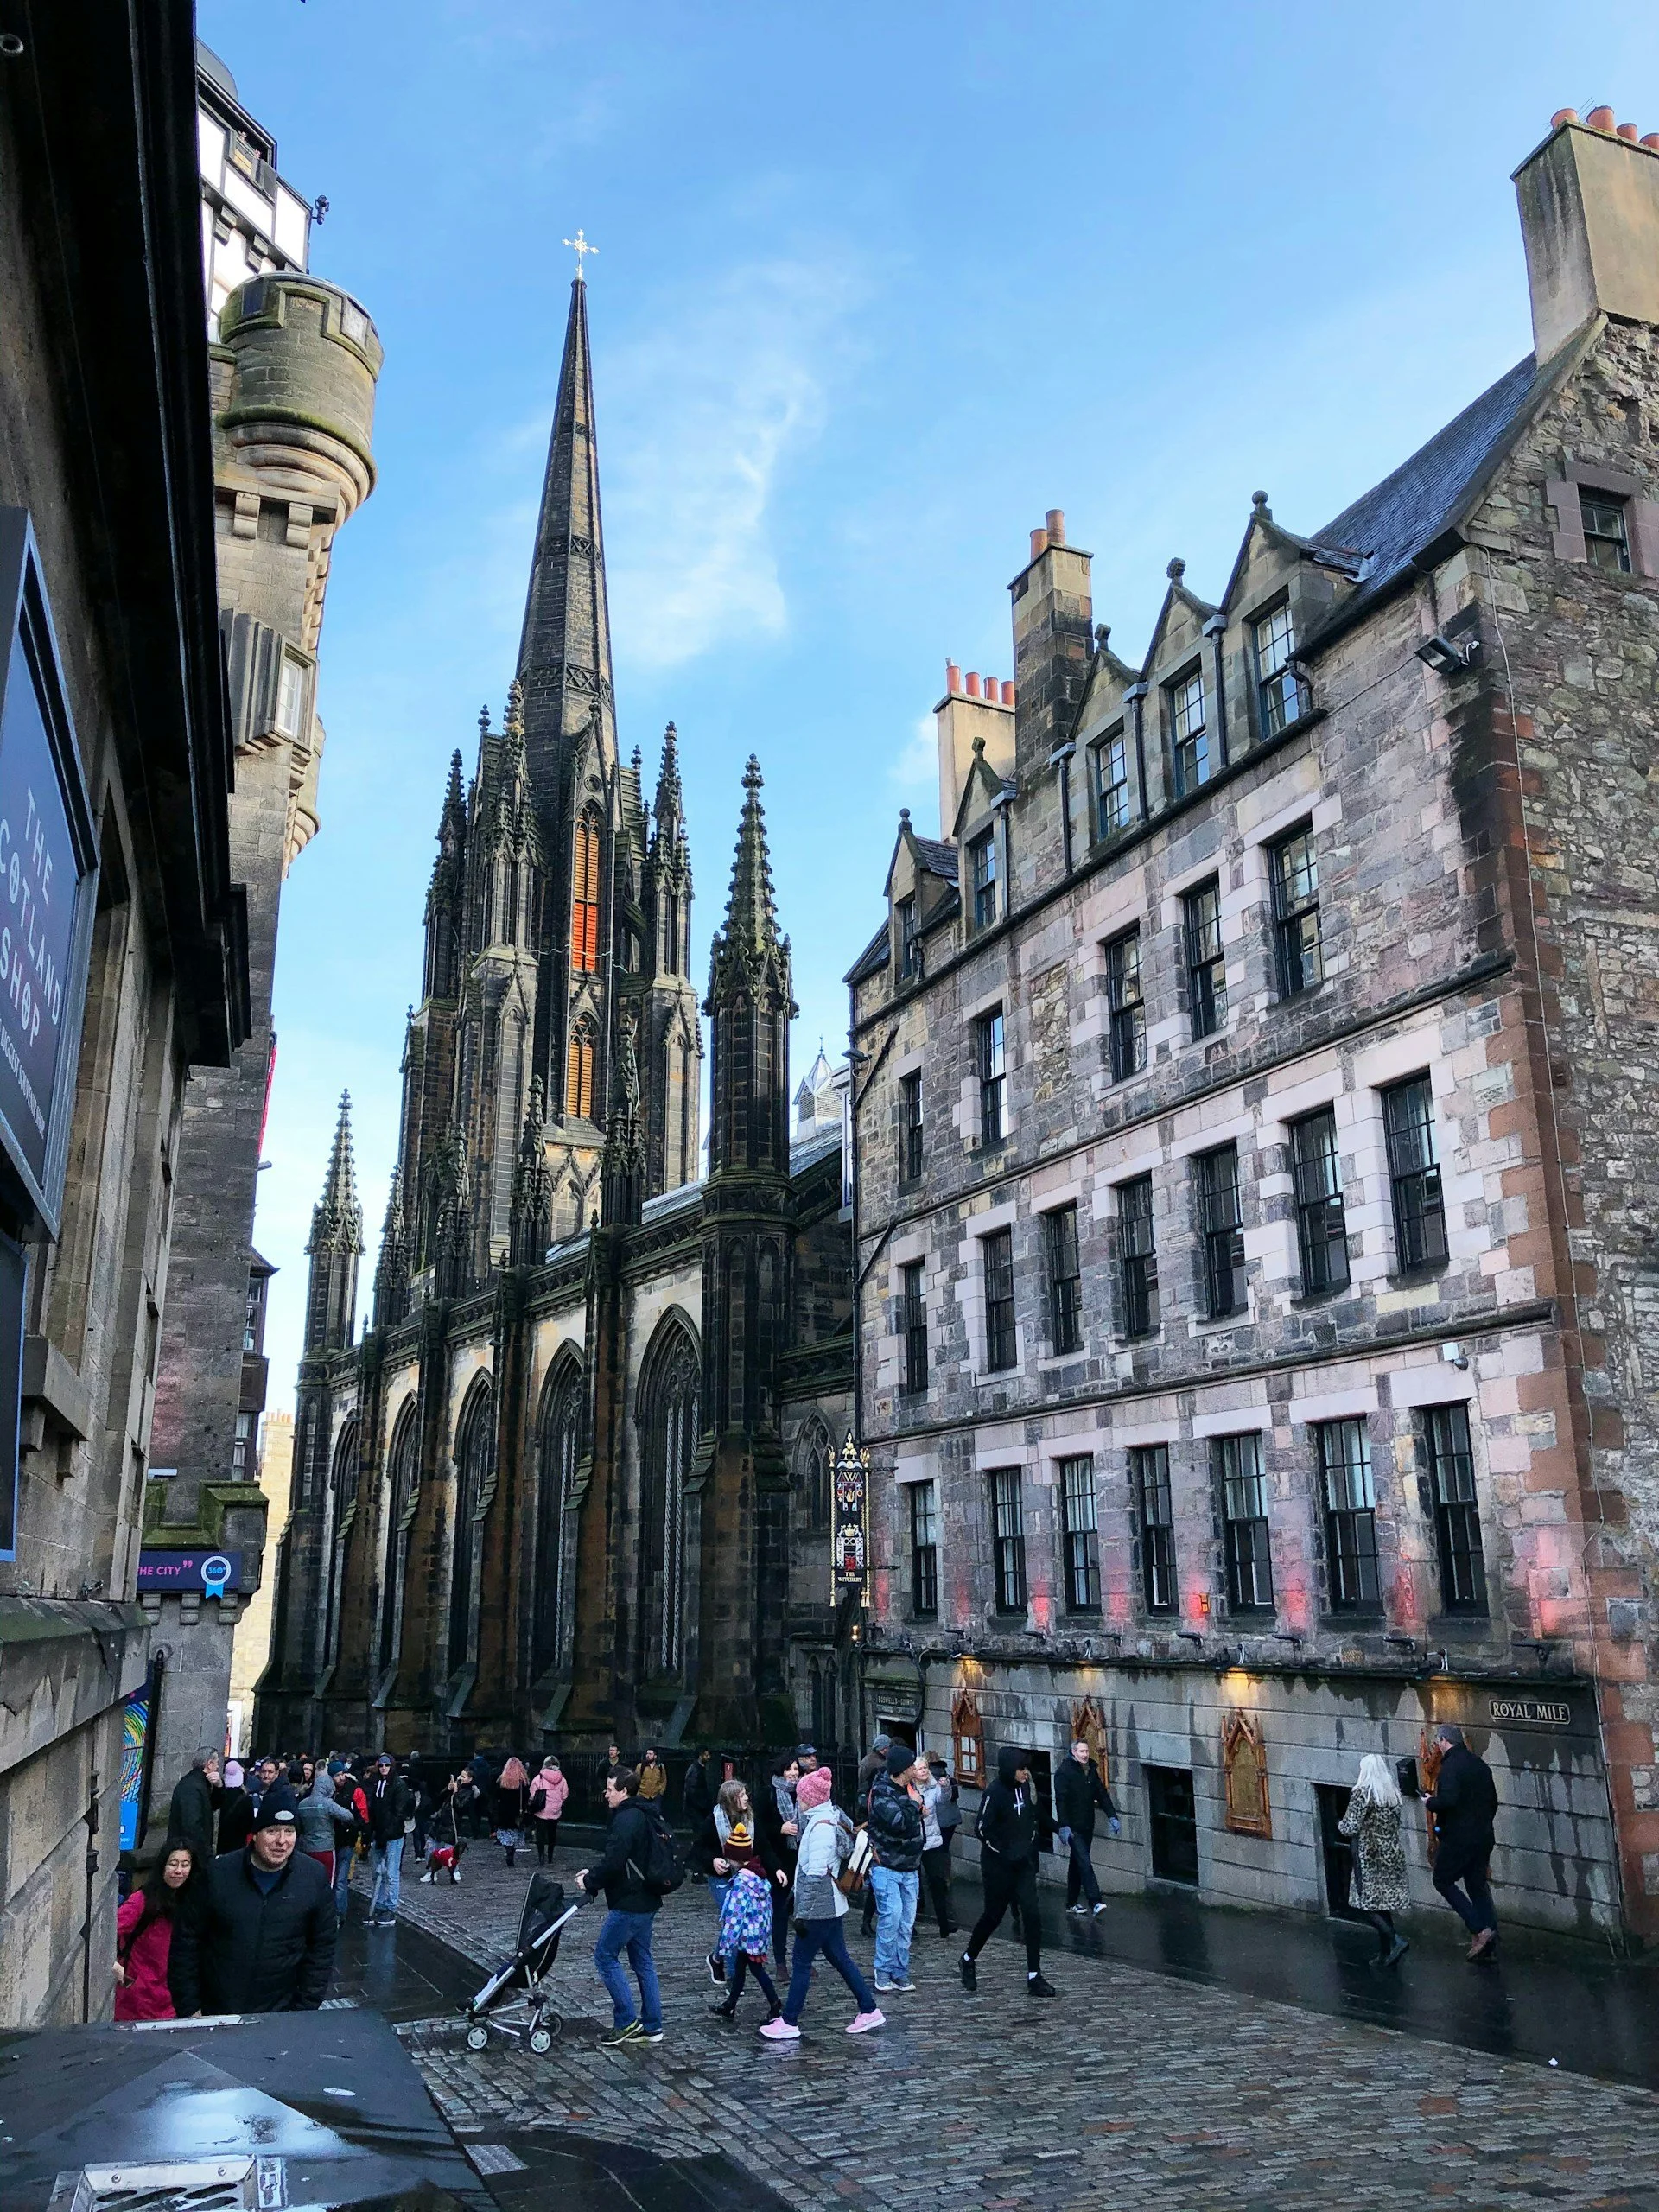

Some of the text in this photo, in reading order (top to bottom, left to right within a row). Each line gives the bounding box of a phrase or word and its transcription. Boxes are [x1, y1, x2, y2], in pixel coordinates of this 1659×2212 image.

[25, 785, 53, 905] THE
[0, 819, 60, 1026] COTLAND
[0, 926, 40, 1047] SHOP
[1492, 1702, 1567, 1721] ROYAL MILE
